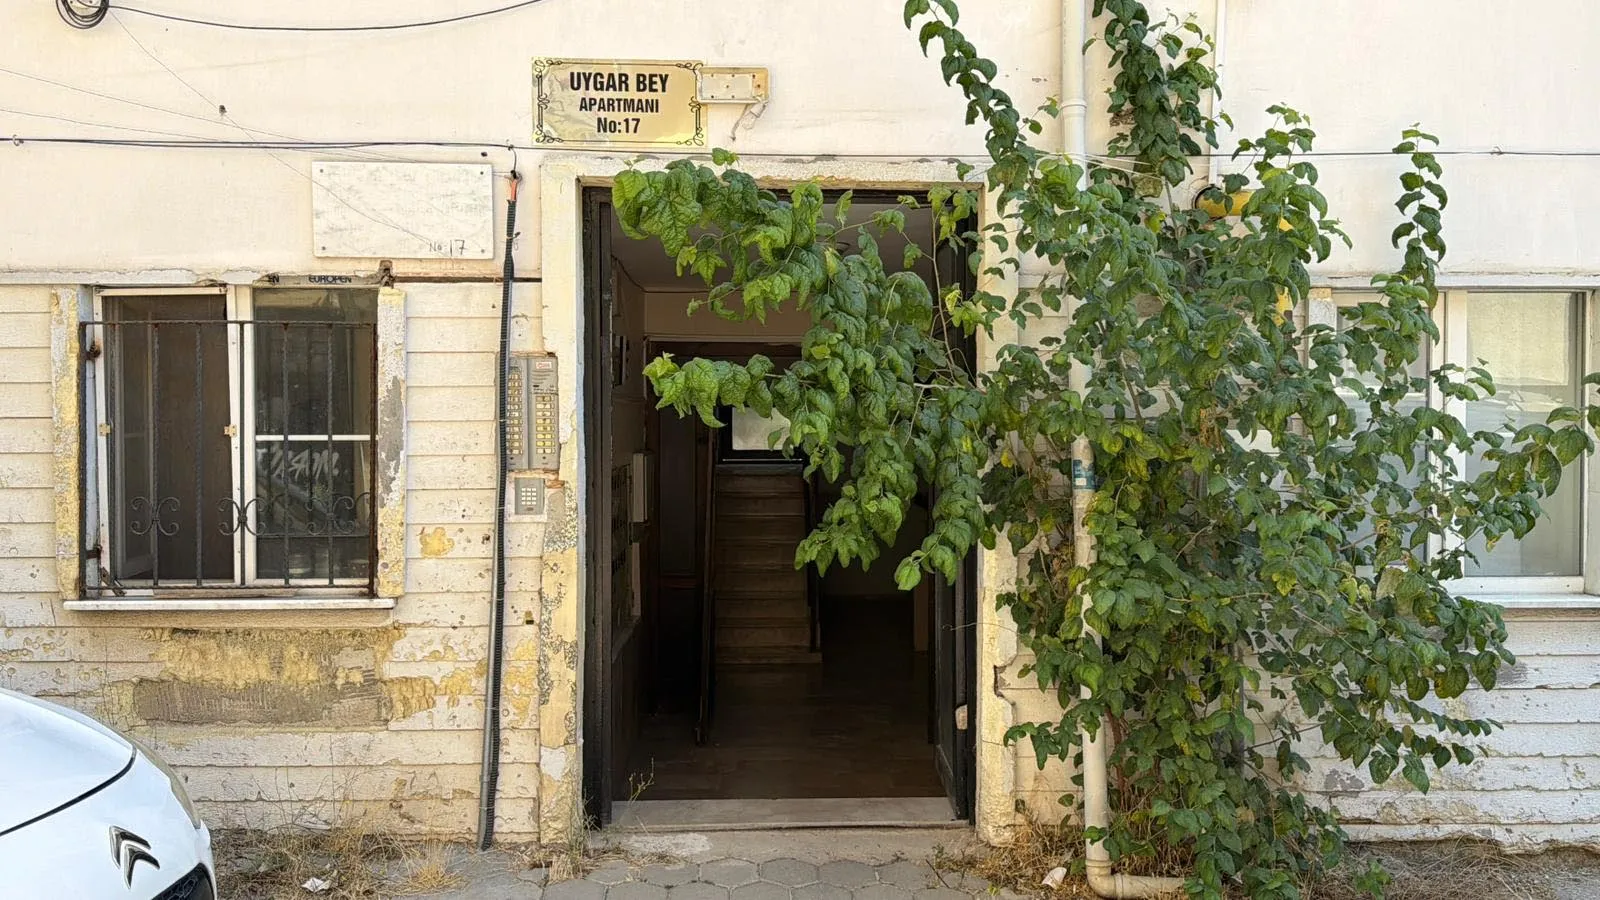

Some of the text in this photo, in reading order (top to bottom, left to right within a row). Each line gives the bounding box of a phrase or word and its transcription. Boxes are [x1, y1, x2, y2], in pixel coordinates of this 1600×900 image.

[569, 71, 669, 93] UYGAR BEY
[579, 97, 659, 113] APARTMANI
[597, 117, 641, 134] No:17
[308, 275, 352, 284] EUROPEN
